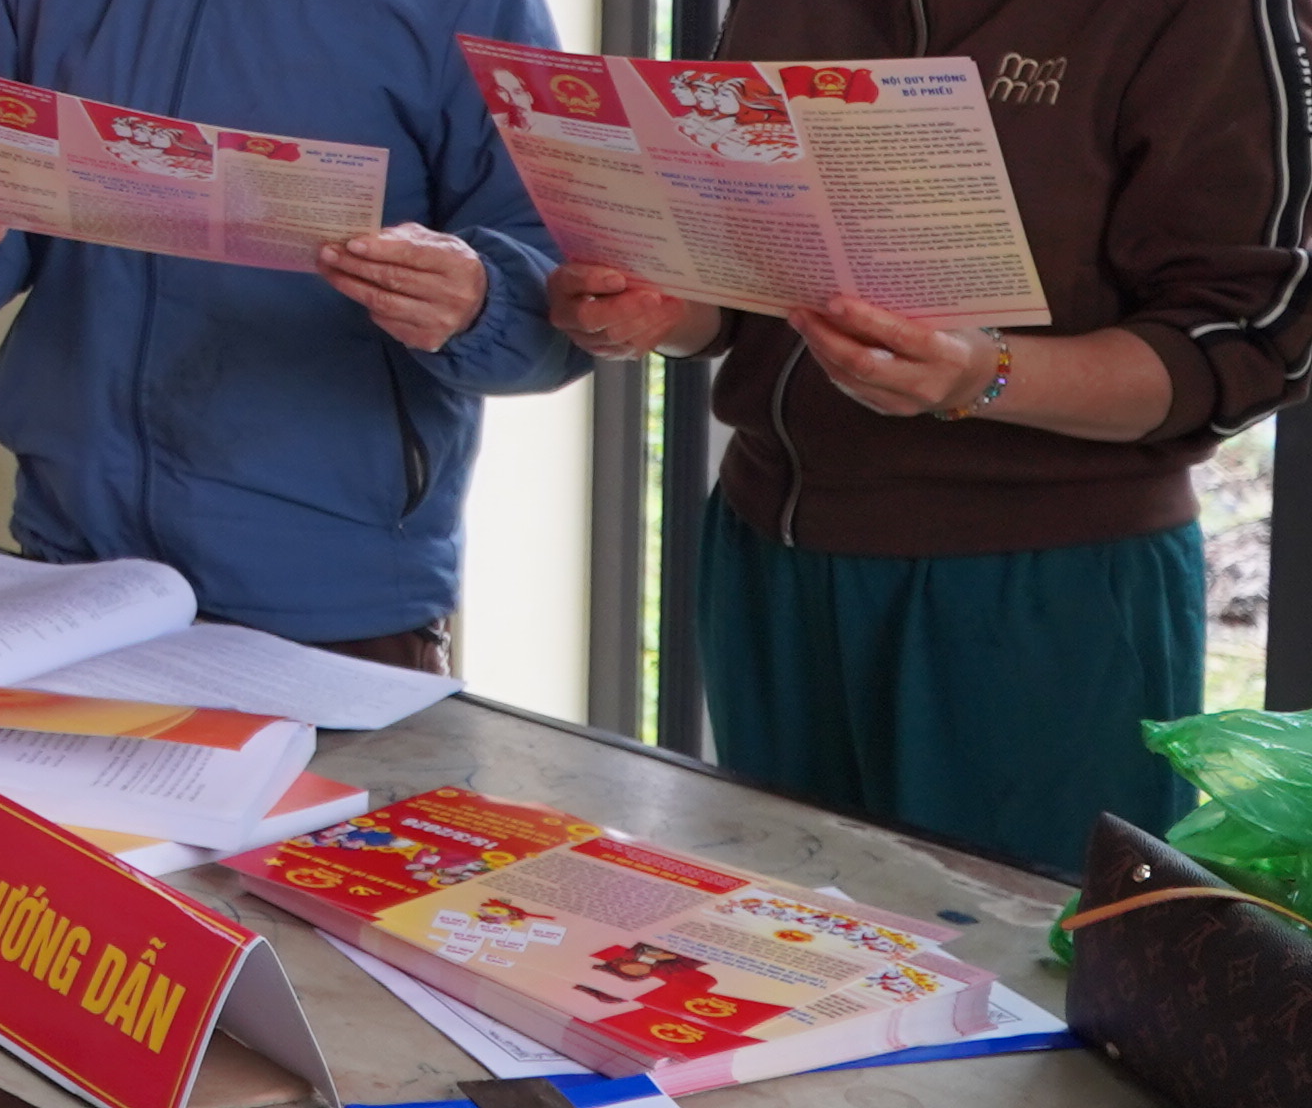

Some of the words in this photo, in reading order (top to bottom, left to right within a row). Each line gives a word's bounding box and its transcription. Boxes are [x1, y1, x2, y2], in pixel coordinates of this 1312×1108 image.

[881, 76, 901, 86] NỘI
[905, 76, 924, 84] QUY
[929, 74, 967, 83] PHÒNG
[81, 937, 187, 1054] DẪN
